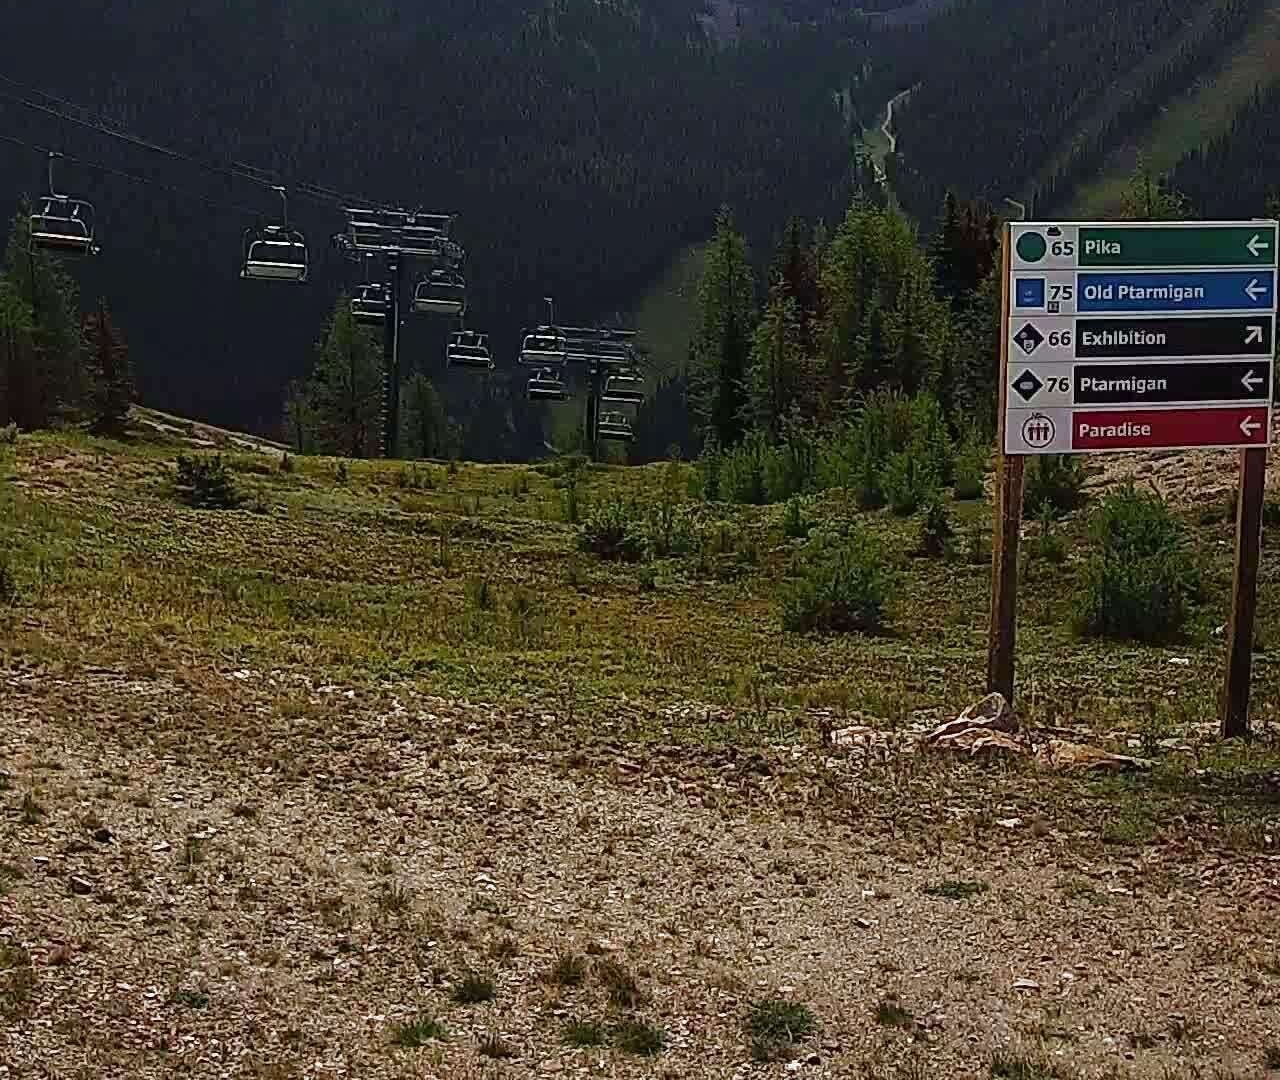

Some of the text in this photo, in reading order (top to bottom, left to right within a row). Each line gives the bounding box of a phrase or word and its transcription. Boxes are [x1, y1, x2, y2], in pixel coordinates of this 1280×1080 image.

[1051, 240, 1121, 256] 65 Pika
[1050, 285, 1204, 301] 75 Old Ptarmigan
[1048, 330, 1166, 346] 66 Exhibition
[1047, 377, 1167, 393] 76 Ptarmigan
[1079, 423, 1151, 438] Paradise
